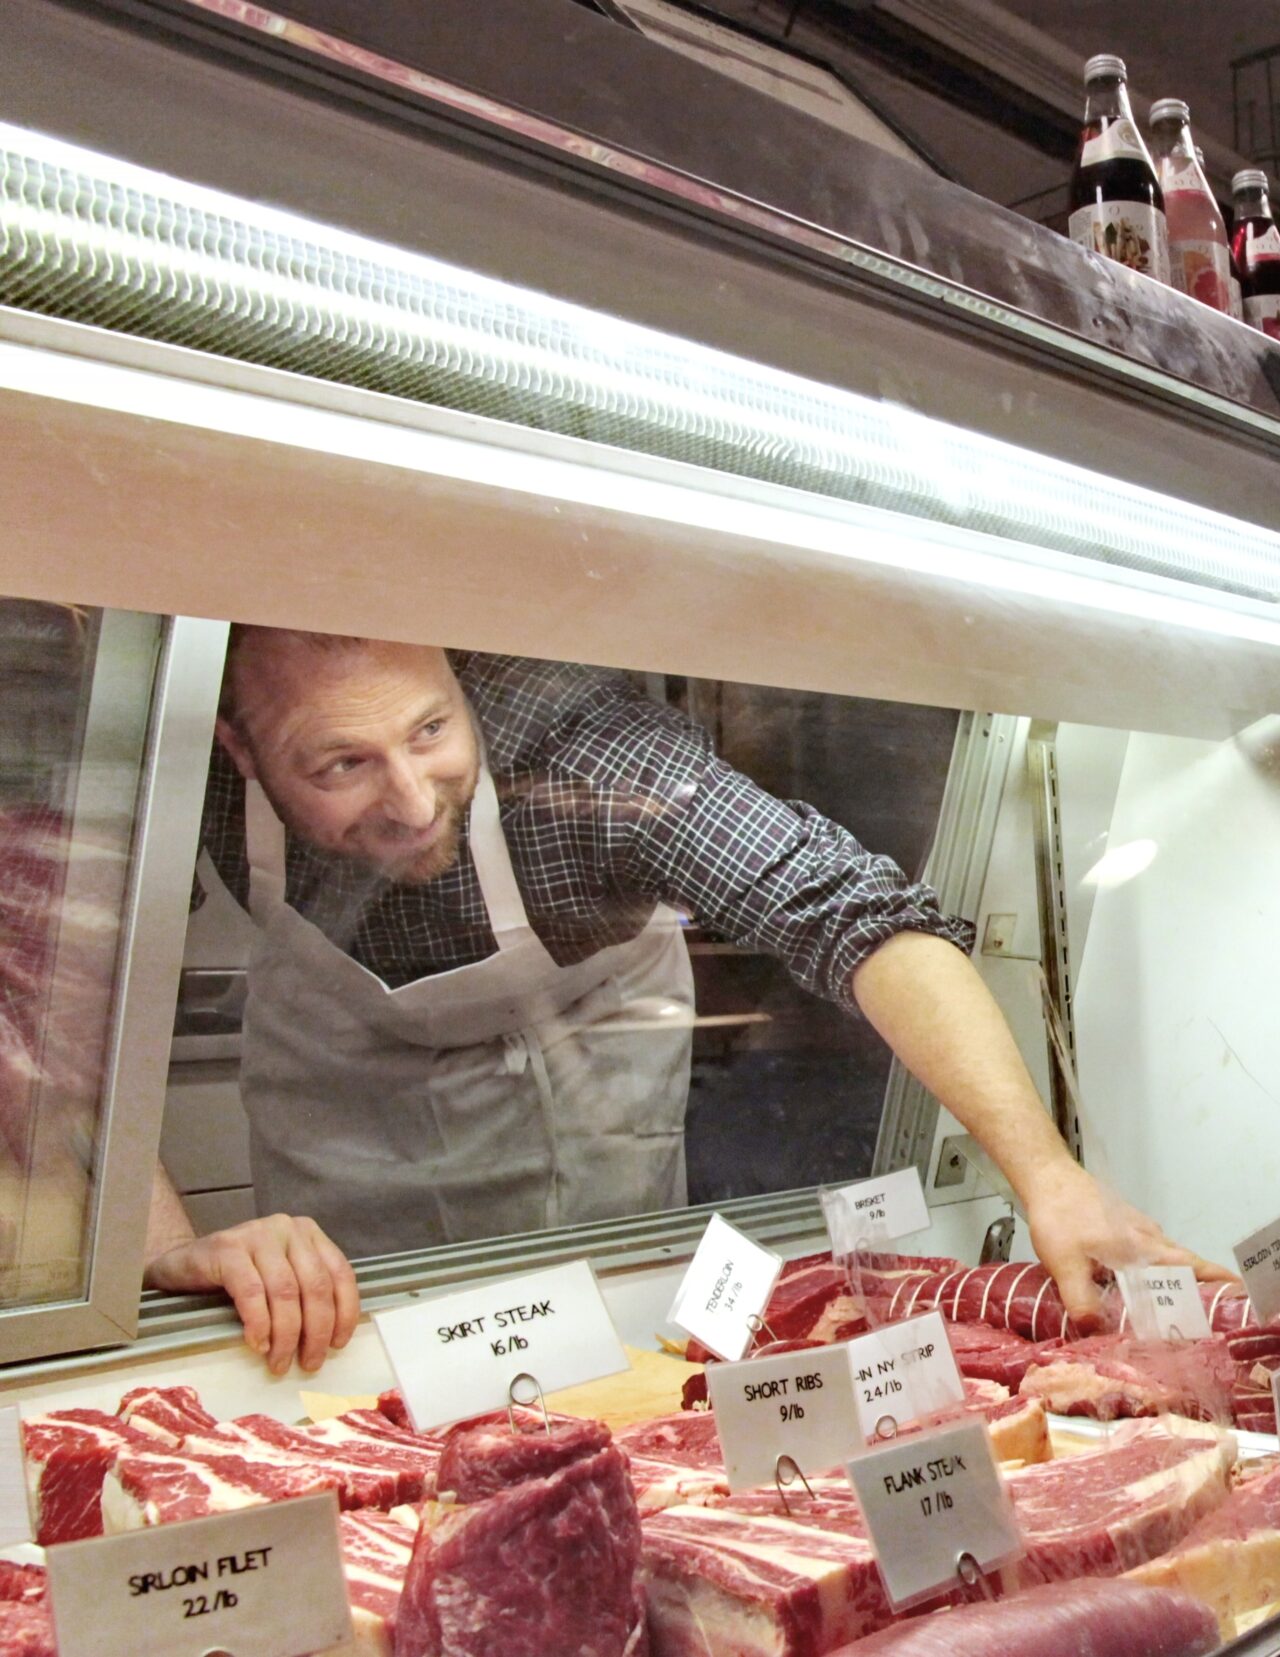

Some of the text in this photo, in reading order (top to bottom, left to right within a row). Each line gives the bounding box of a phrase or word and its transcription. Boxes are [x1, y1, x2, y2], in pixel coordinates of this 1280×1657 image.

[855, 1193, 886, 1210] BRISKET
[705, 1259, 734, 1314] TENDERLOIN
[437, 1299, 555, 1343] SKIRT STEAK
[877, 1359, 896, 1377] NY
[744, 1372, 824, 1402] SHORT RIBS
[863, 1379, 903, 1403] 24/lb
[779, 1403, 805, 1422] 9/lb
[883, 1467, 926, 1494] FLANK
[128, 1546, 273, 1597] SIRLOIN FILET
